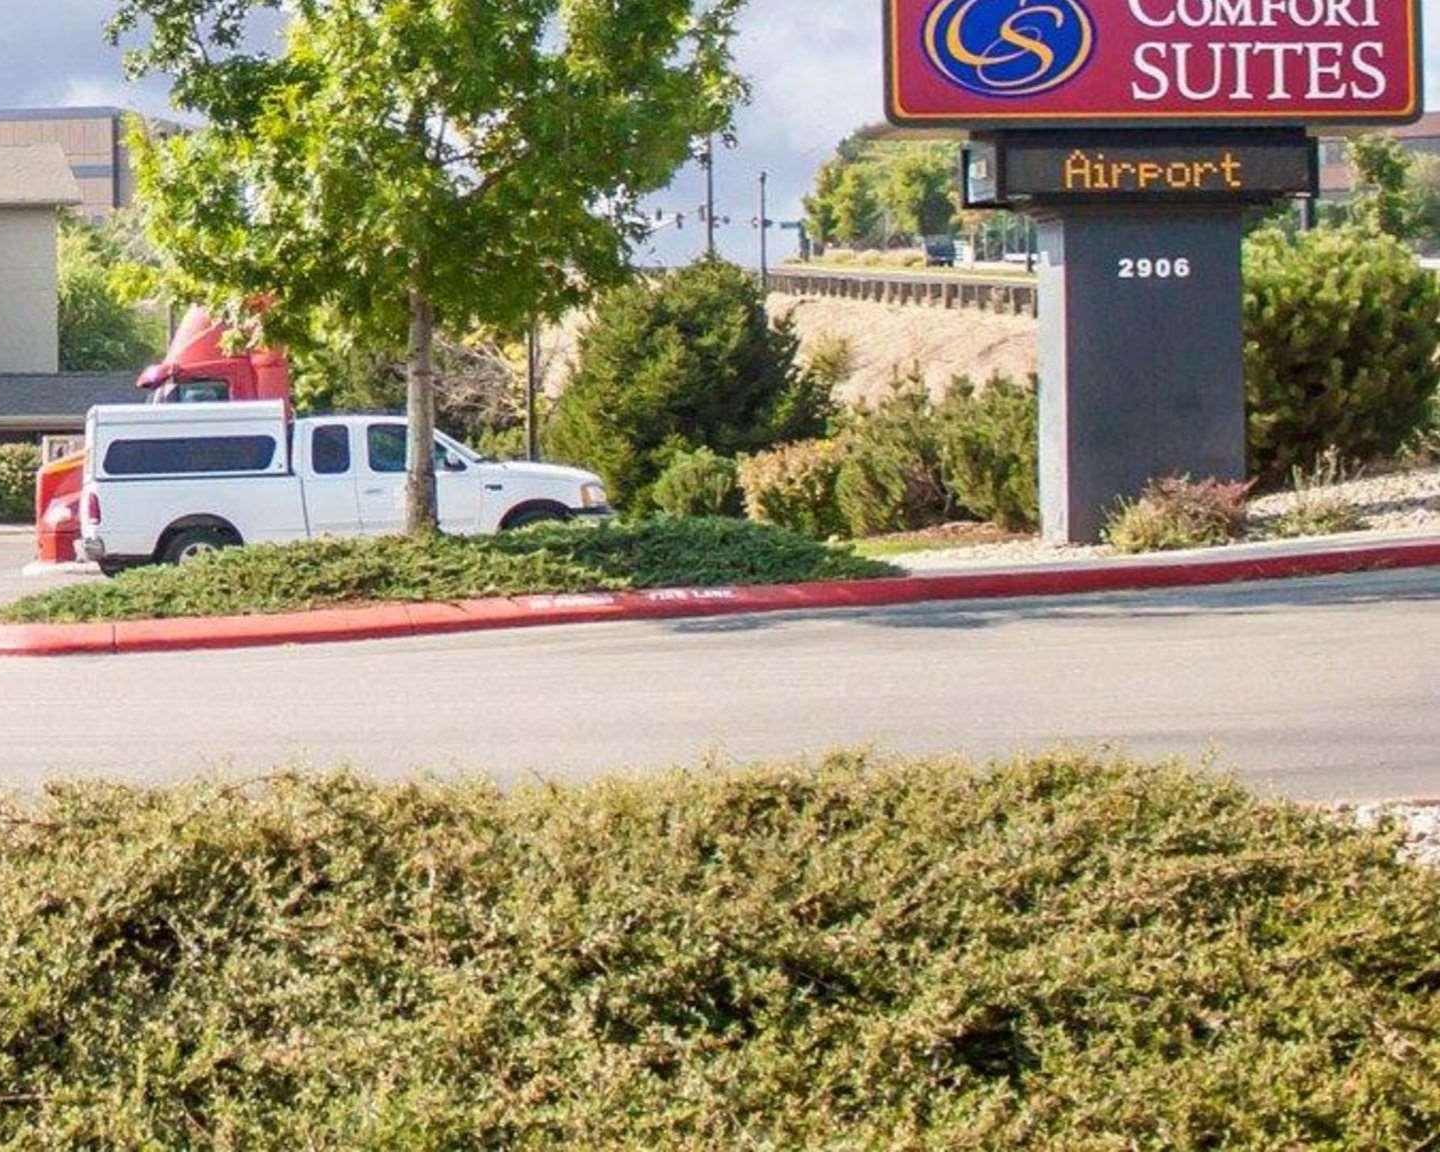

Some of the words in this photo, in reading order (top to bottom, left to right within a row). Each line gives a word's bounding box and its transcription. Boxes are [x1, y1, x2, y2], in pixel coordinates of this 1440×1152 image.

[1131, 41, 1387, 100] SUITES
[1065, 149, 1242, 189] Airport
[1117, 258, 1191, 278] 2906
